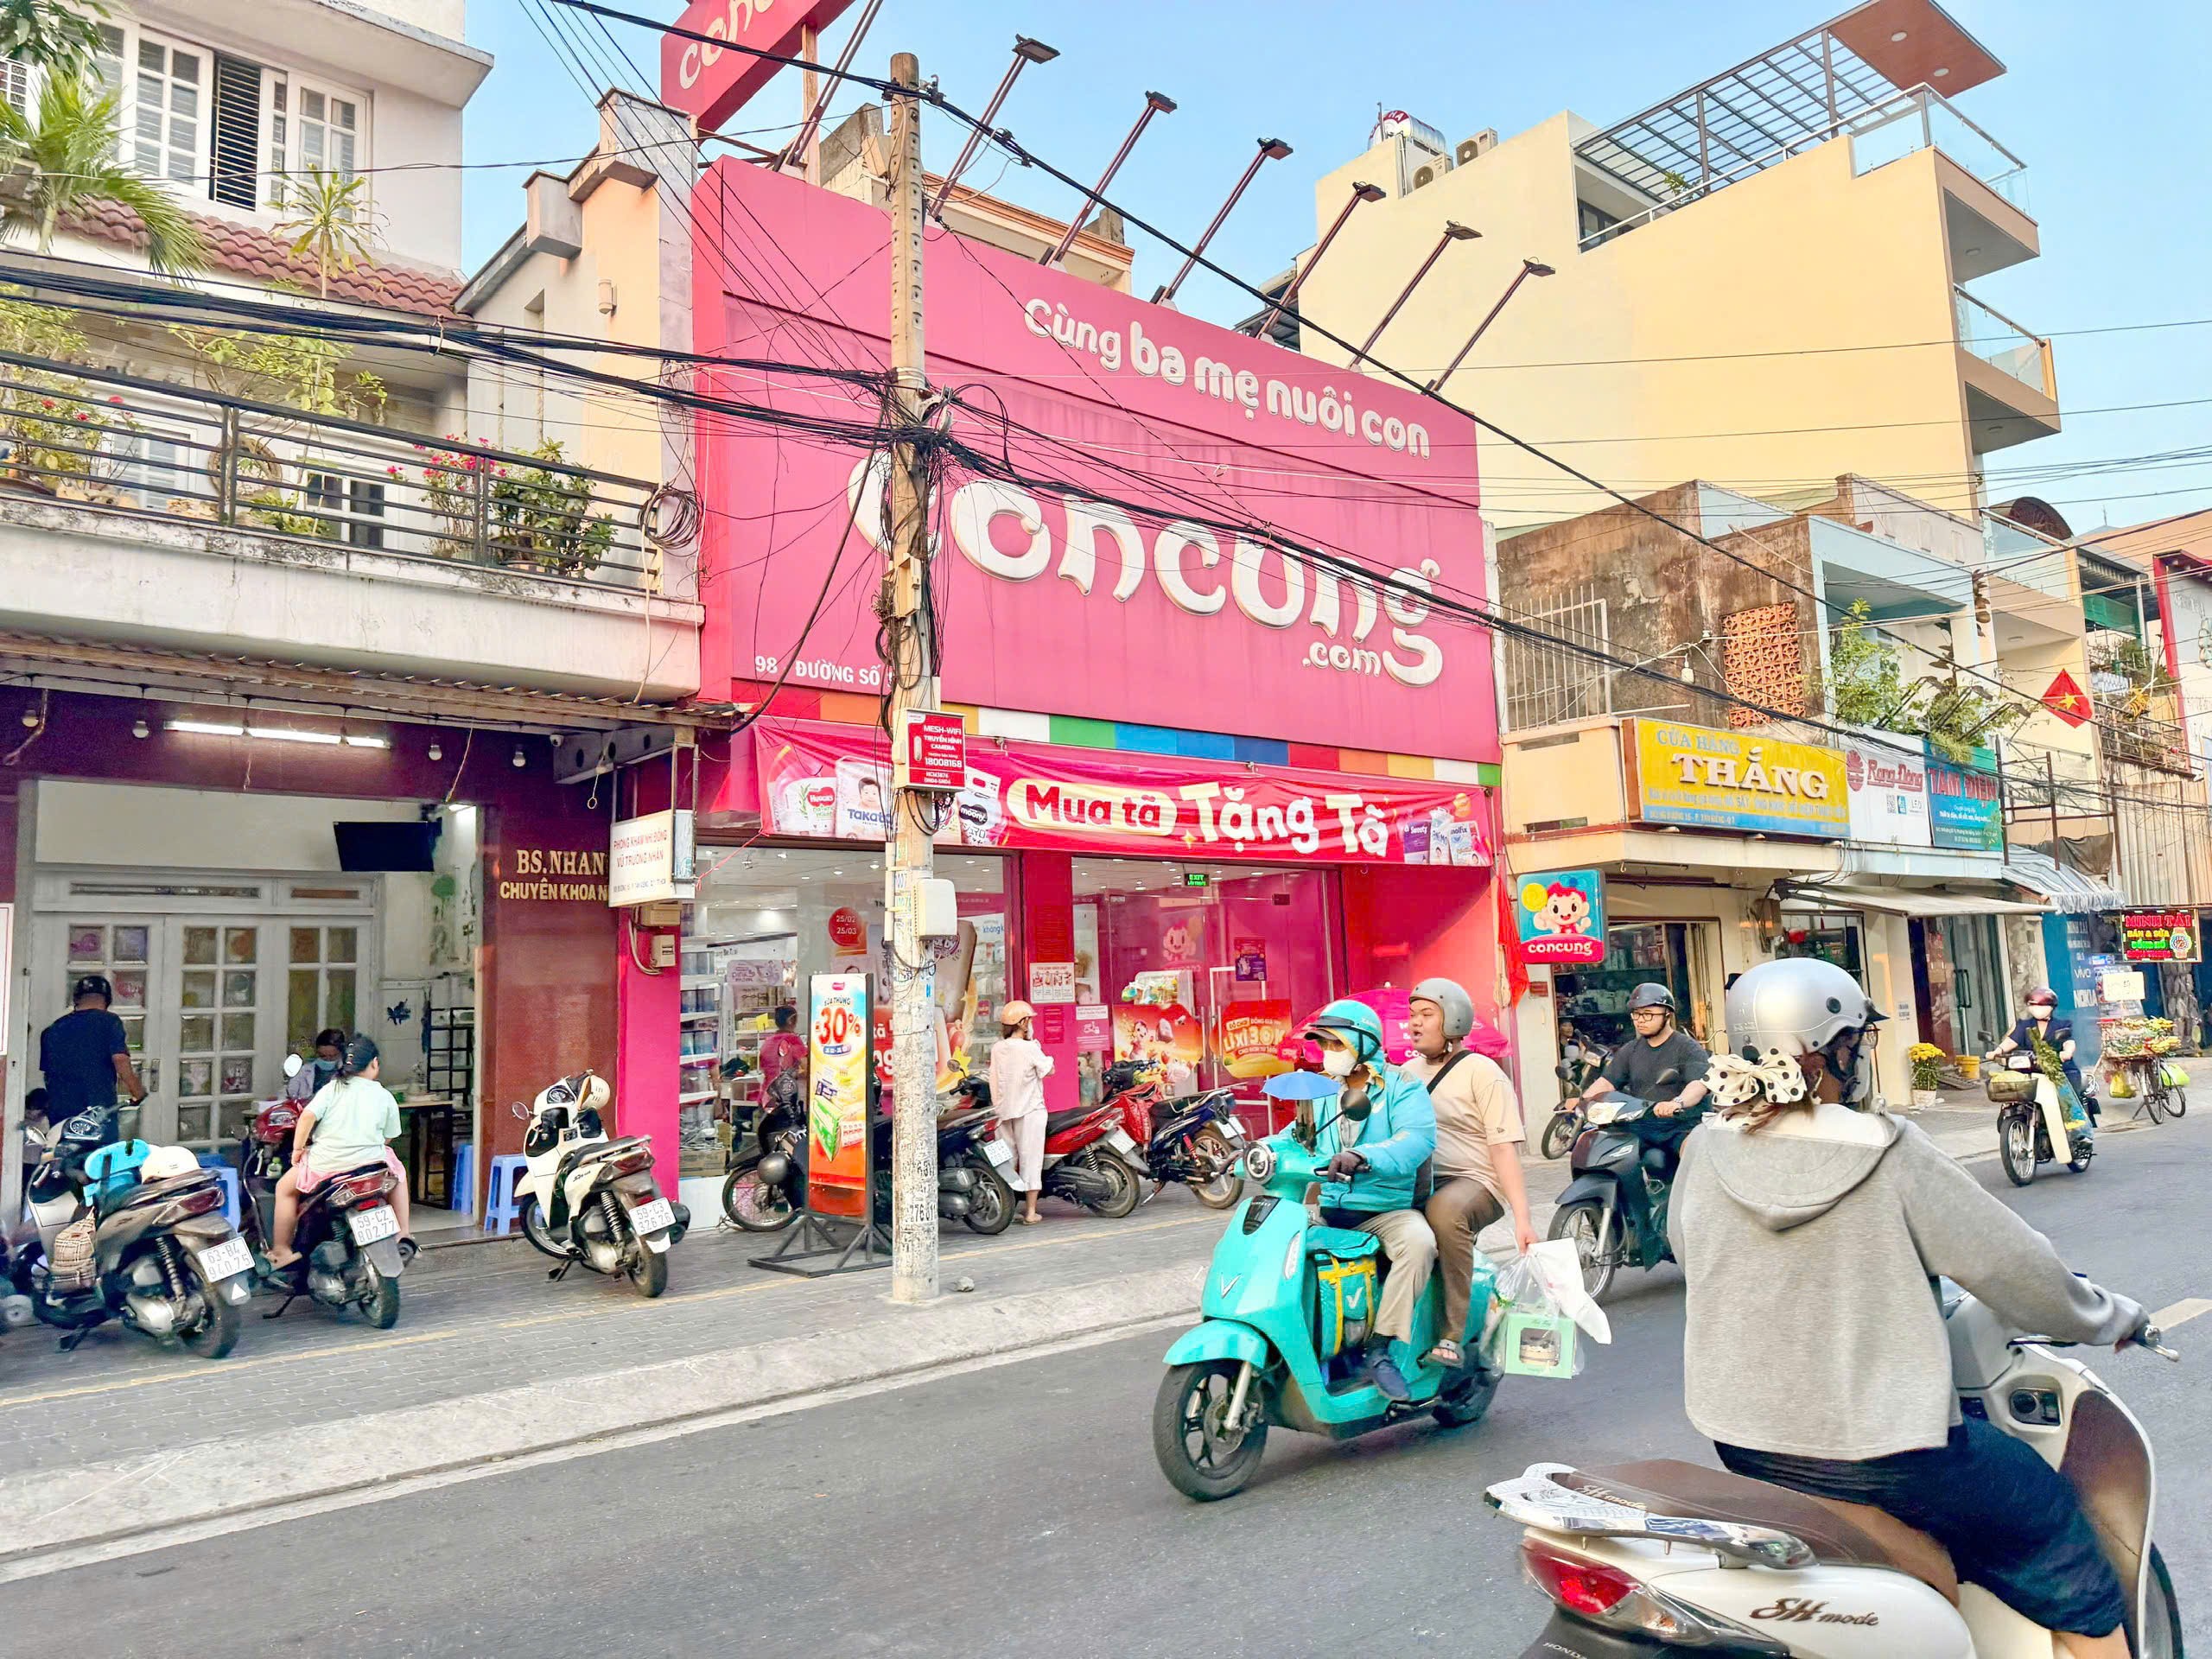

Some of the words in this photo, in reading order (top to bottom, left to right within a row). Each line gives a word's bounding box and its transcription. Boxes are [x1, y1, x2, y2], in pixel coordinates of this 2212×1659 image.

[1024, 297, 1122, 372] Cùng
[1130, 321, 1186, 386] ba
[1194, 356, 1260, 421] mẹ
[1266, 379, 1357, 437] nuôi
[1361, 410, 1430, 460] con
[1302, 642, 1382, 677] .com
[754, 655, 778, 674] 98
[795, 658, 855, 683] ĐƯỜNG
[859, 664, 881, 686] SỐ
[923, 725, 962, 735] MESH-WIFI
[1657, 728, 1691, 747] CỬA
[1697, 734, 1740, 754] HÀNG
[1671, 746, 1829, 799] THẮNG
[960, 807, 985, 822] moony
[1026, 785, 1112, 825] Mua
[1122, 794, 1161, 828] tã
[1179, 781, 1319, 855] Tặng
[500, 877, 558, 899] CHUYÊN
[560, 884, 596, 900] KHOA
[836, 915, 856, 924] 25/02
[2126, 915, 2162, 927] MINH
[836, 927, 857, 936] 25/03
[1528, 941, 1592, 956] concung
[356, 1210, 389, 1228] 59-C2
[358, 1220, 395, 1243] 802.77
[1815, 1610, 1879, 1627] mode
